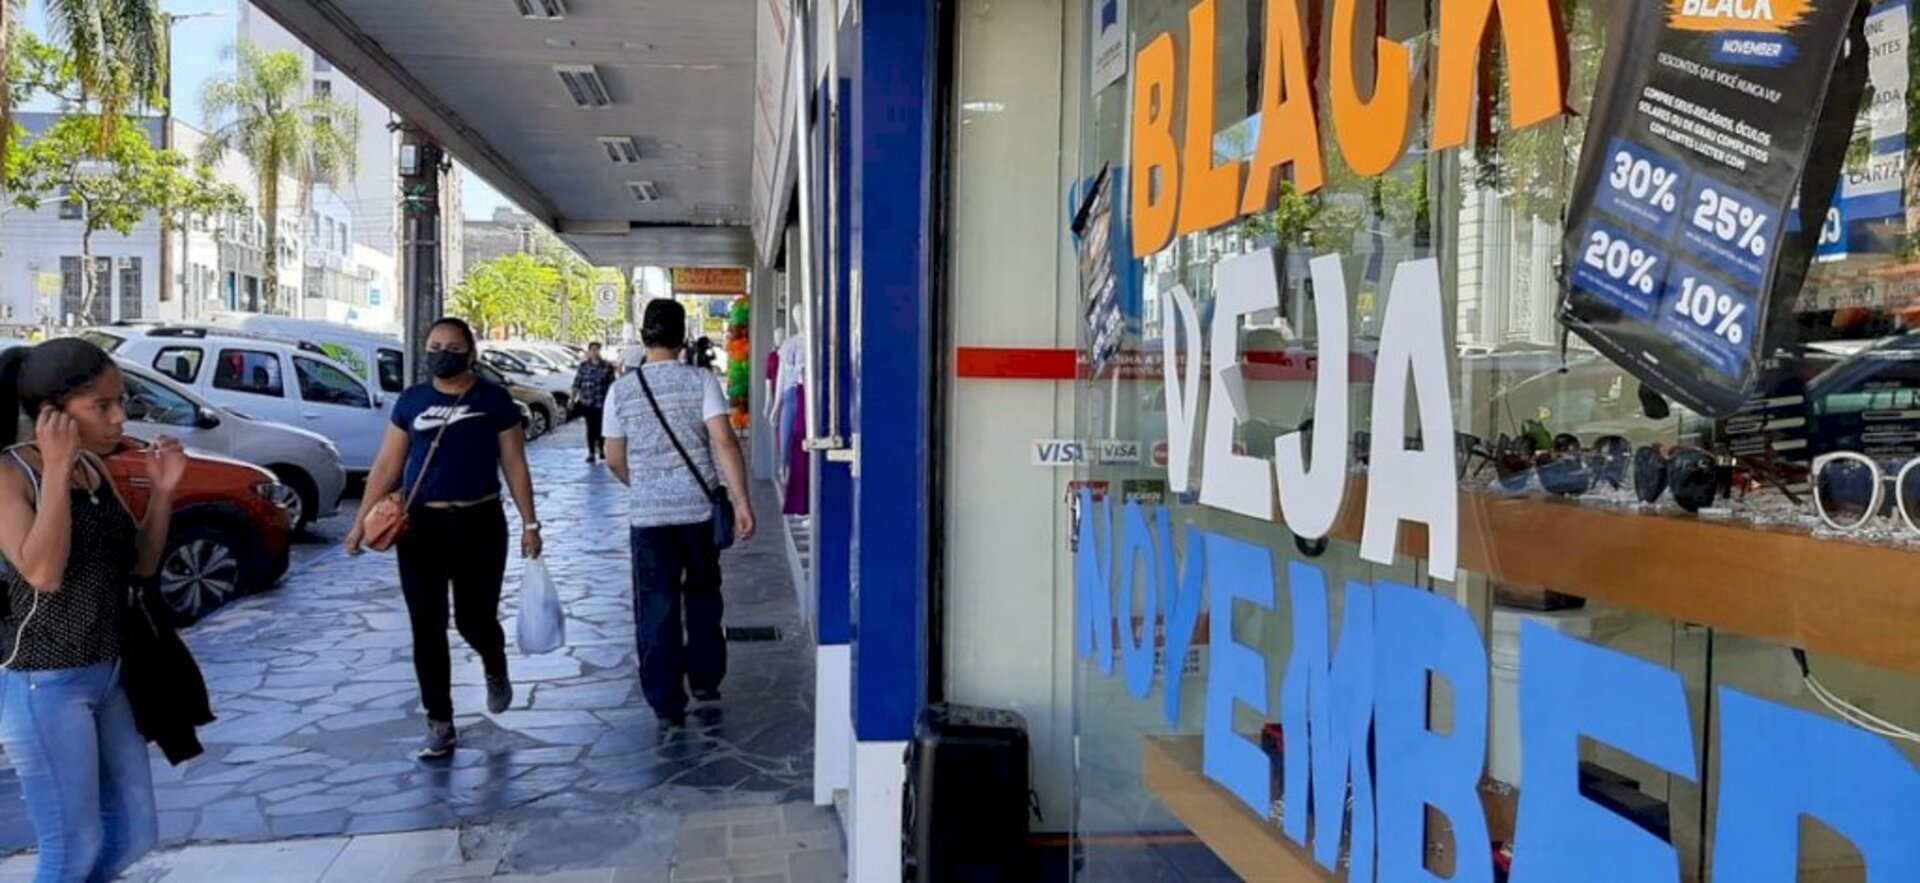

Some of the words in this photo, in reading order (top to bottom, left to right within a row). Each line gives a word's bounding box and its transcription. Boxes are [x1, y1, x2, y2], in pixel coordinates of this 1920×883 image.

[1681, 0, 1774, 20] BLACK
[1720, 39, 1783, 57] NOVEMBER
[1643, 86, 1675, 107] COMPRE
[1673, 98, 1695, 115] SEUS
[1638, 100, 1672, 123] SOLARES
[1716, 132, 1769, 164] COMPLETOS
[1650, 121, 1667, 135] COM
[1665, 128, 1695, 149] LENTES
[1724, 153, 1747, 171] COM
[1610, 151, 1677, 212] 30%
[1693, 188, 1767, 256] 25%
[1584, 230, 1657, 293] 20%
[603, 290, 611, 301] E
[1675, 277, 1746, 344] 10%
[1163, 246, 1458, 582] VEJA
[1036, 442, 1084, 462] VISA
[1104, 444, 1138, 458] VISA
